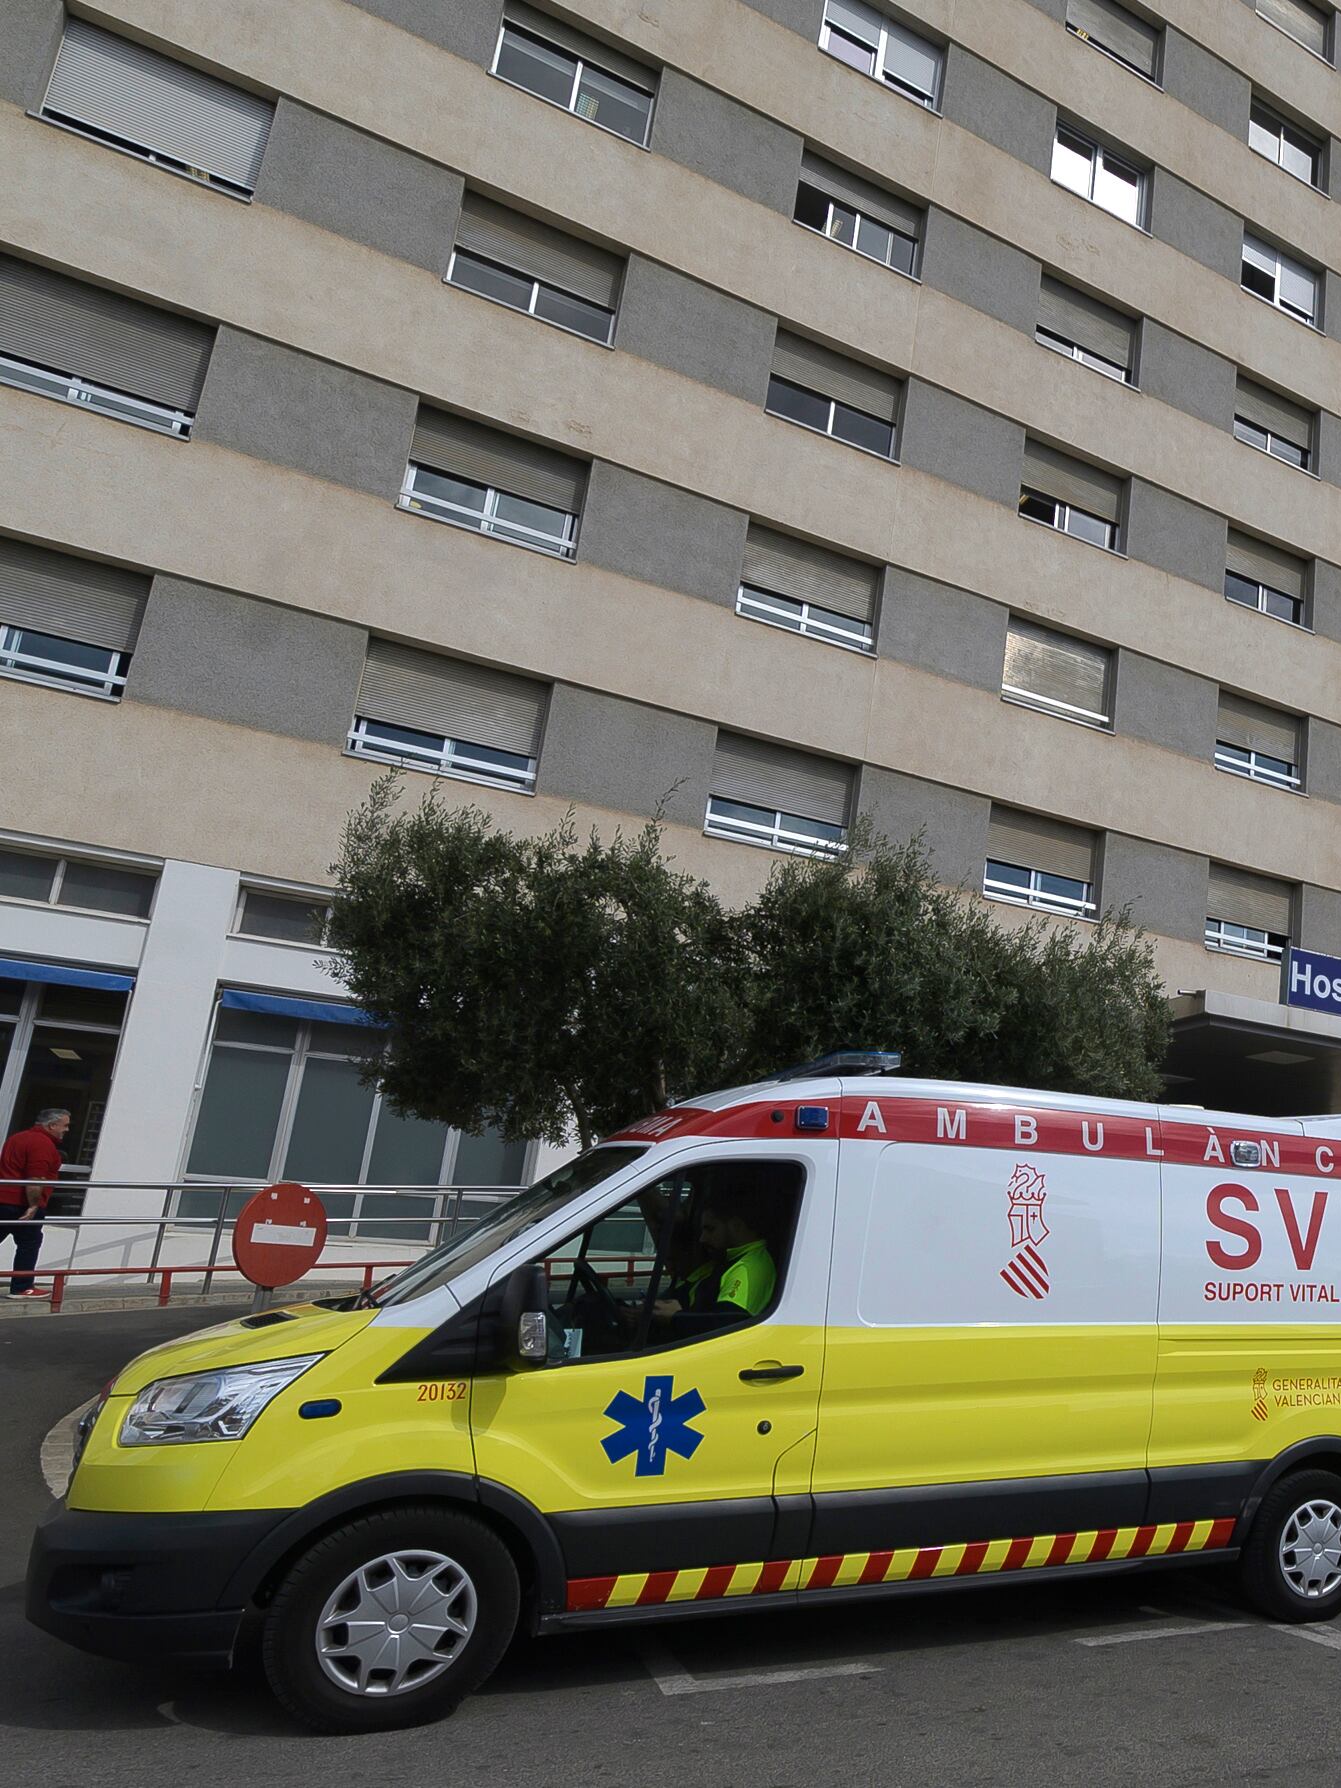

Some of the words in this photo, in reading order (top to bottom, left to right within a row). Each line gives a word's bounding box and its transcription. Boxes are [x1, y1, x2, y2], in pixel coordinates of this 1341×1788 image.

[1204, 1281, 1284, 1302] SUPORT
[1289, 1283, 1340, 1303] VITAL
[417, 1382, 467, 1401] 20132
